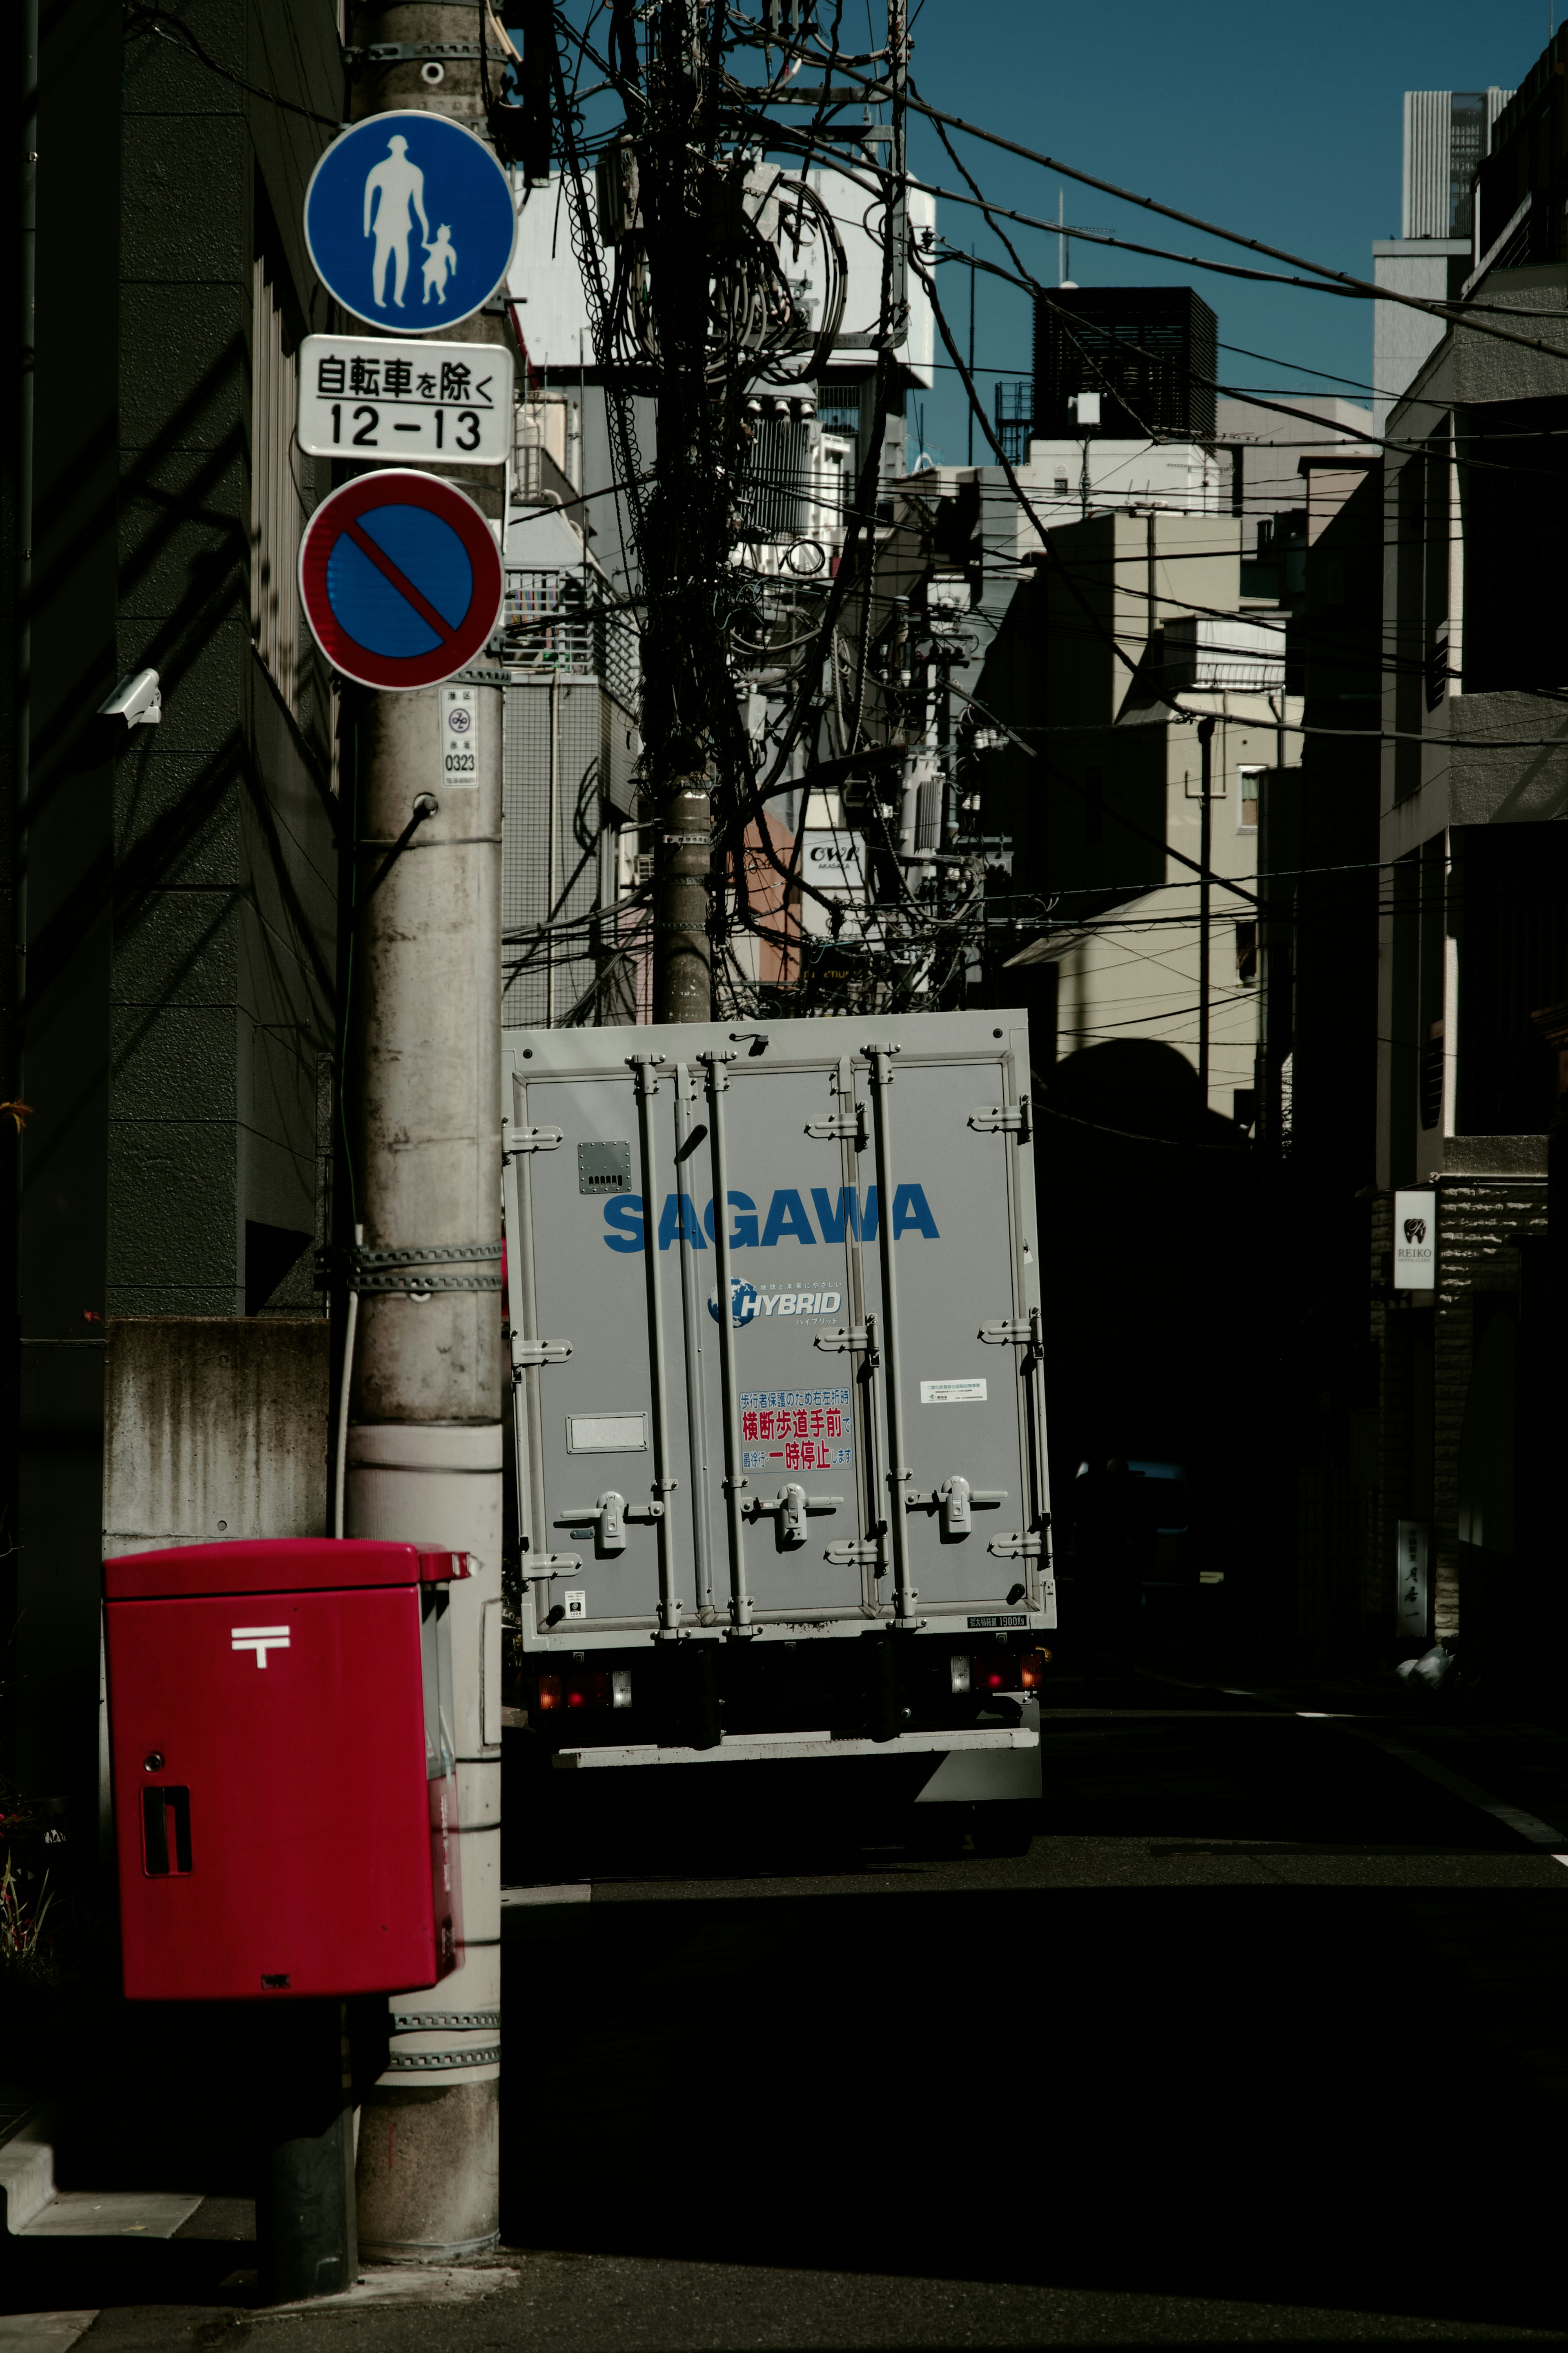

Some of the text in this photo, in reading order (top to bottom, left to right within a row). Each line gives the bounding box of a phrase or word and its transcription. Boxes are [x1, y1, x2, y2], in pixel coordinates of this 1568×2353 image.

[318, 354, 493, 402] 自転車を除く
[445, 754, 474, 771] 0323
[603, 1183, 940, 1253] SAGAWA
[1398, 1249, 1432, 1258] REIKO
[743, 1281, 843, 1292] 人と地球と未来にやさしい
[740, 1291, 842, 1318] HYBRID
[795, 1317, 839, 1326] ハイブリッド
[741, 1389, 849, 1409] 歩行者保護のため右左折時
[742, 1407, 850, 1441] 横断歩道手前で
[969, 1617, 997, 1627] 最大積載量
